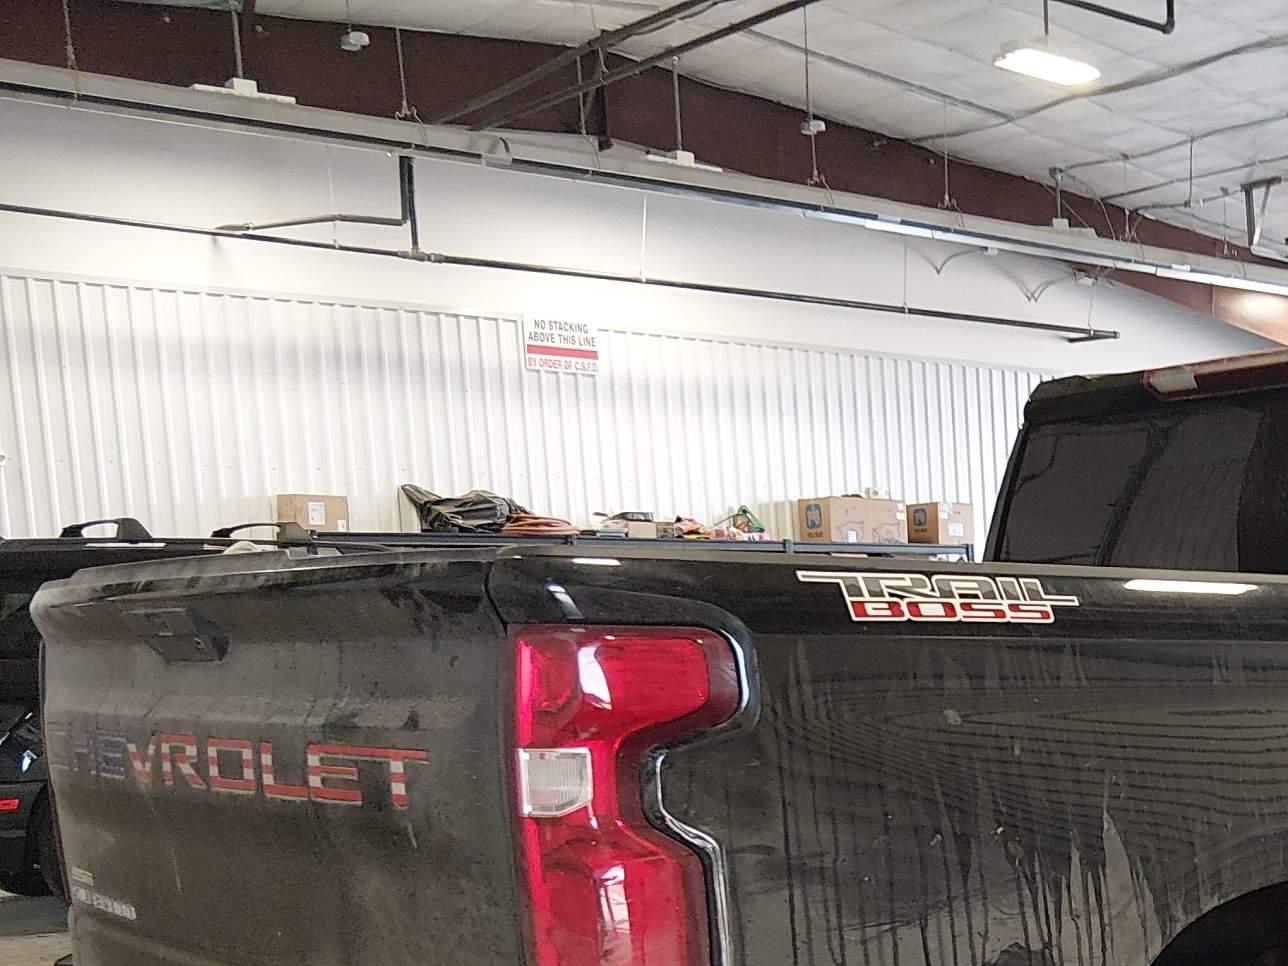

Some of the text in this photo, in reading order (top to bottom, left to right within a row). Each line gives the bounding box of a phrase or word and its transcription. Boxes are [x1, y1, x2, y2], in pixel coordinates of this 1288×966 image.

[534, 319, 589, 335] NO STACKING
[528, 331, 597, 348] ABOVE THIS LINE
[527, 357, 537, 368] BY
[539, 358, 562, 370] ORDER
[564, 360, 573, 371] OF
[796, 570, 1080, 607] TRAIL
[850, 599, 1055, 623] BOSS
